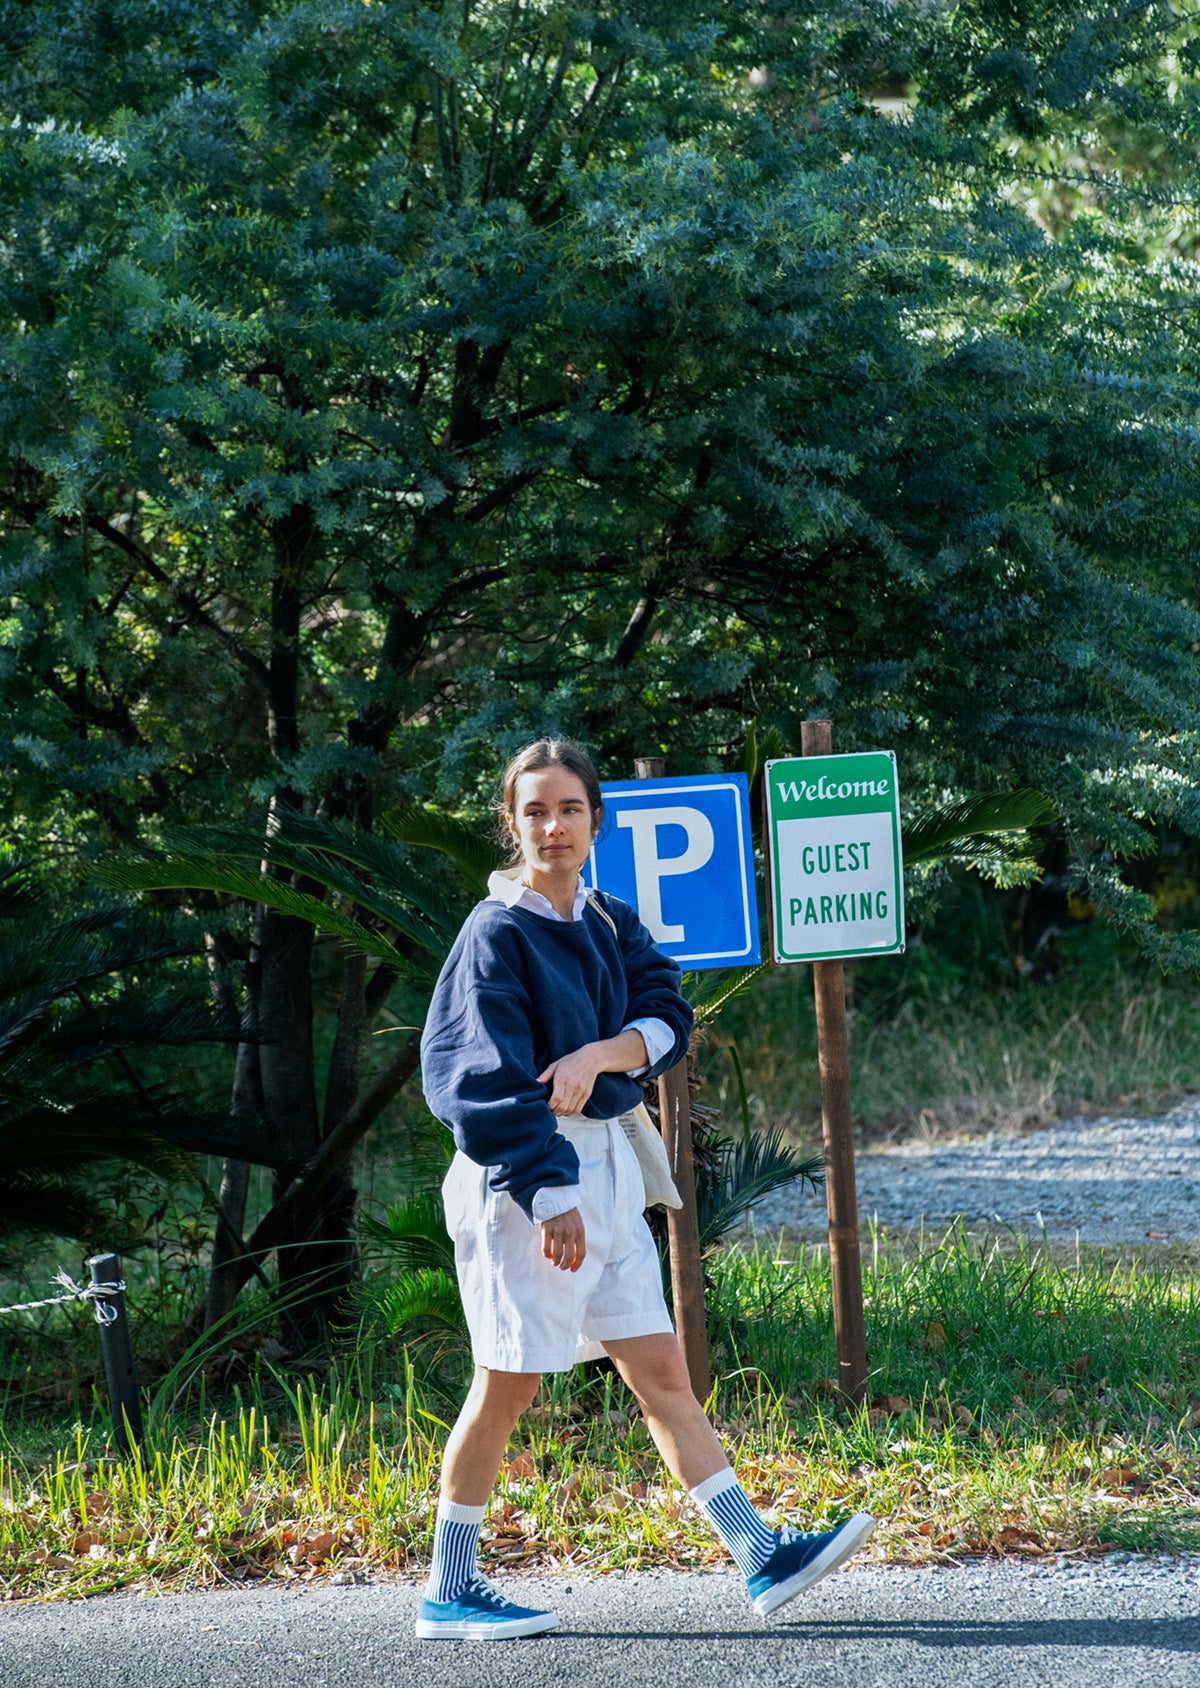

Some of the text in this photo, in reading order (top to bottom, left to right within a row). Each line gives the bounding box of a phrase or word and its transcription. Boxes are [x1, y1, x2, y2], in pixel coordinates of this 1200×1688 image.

[776, 775, 890, 803] Welcome
[616, 806, 715, 943] P
[802, 841, 871, 875] GUEST
[789, 891, 888, 926] PARKING
